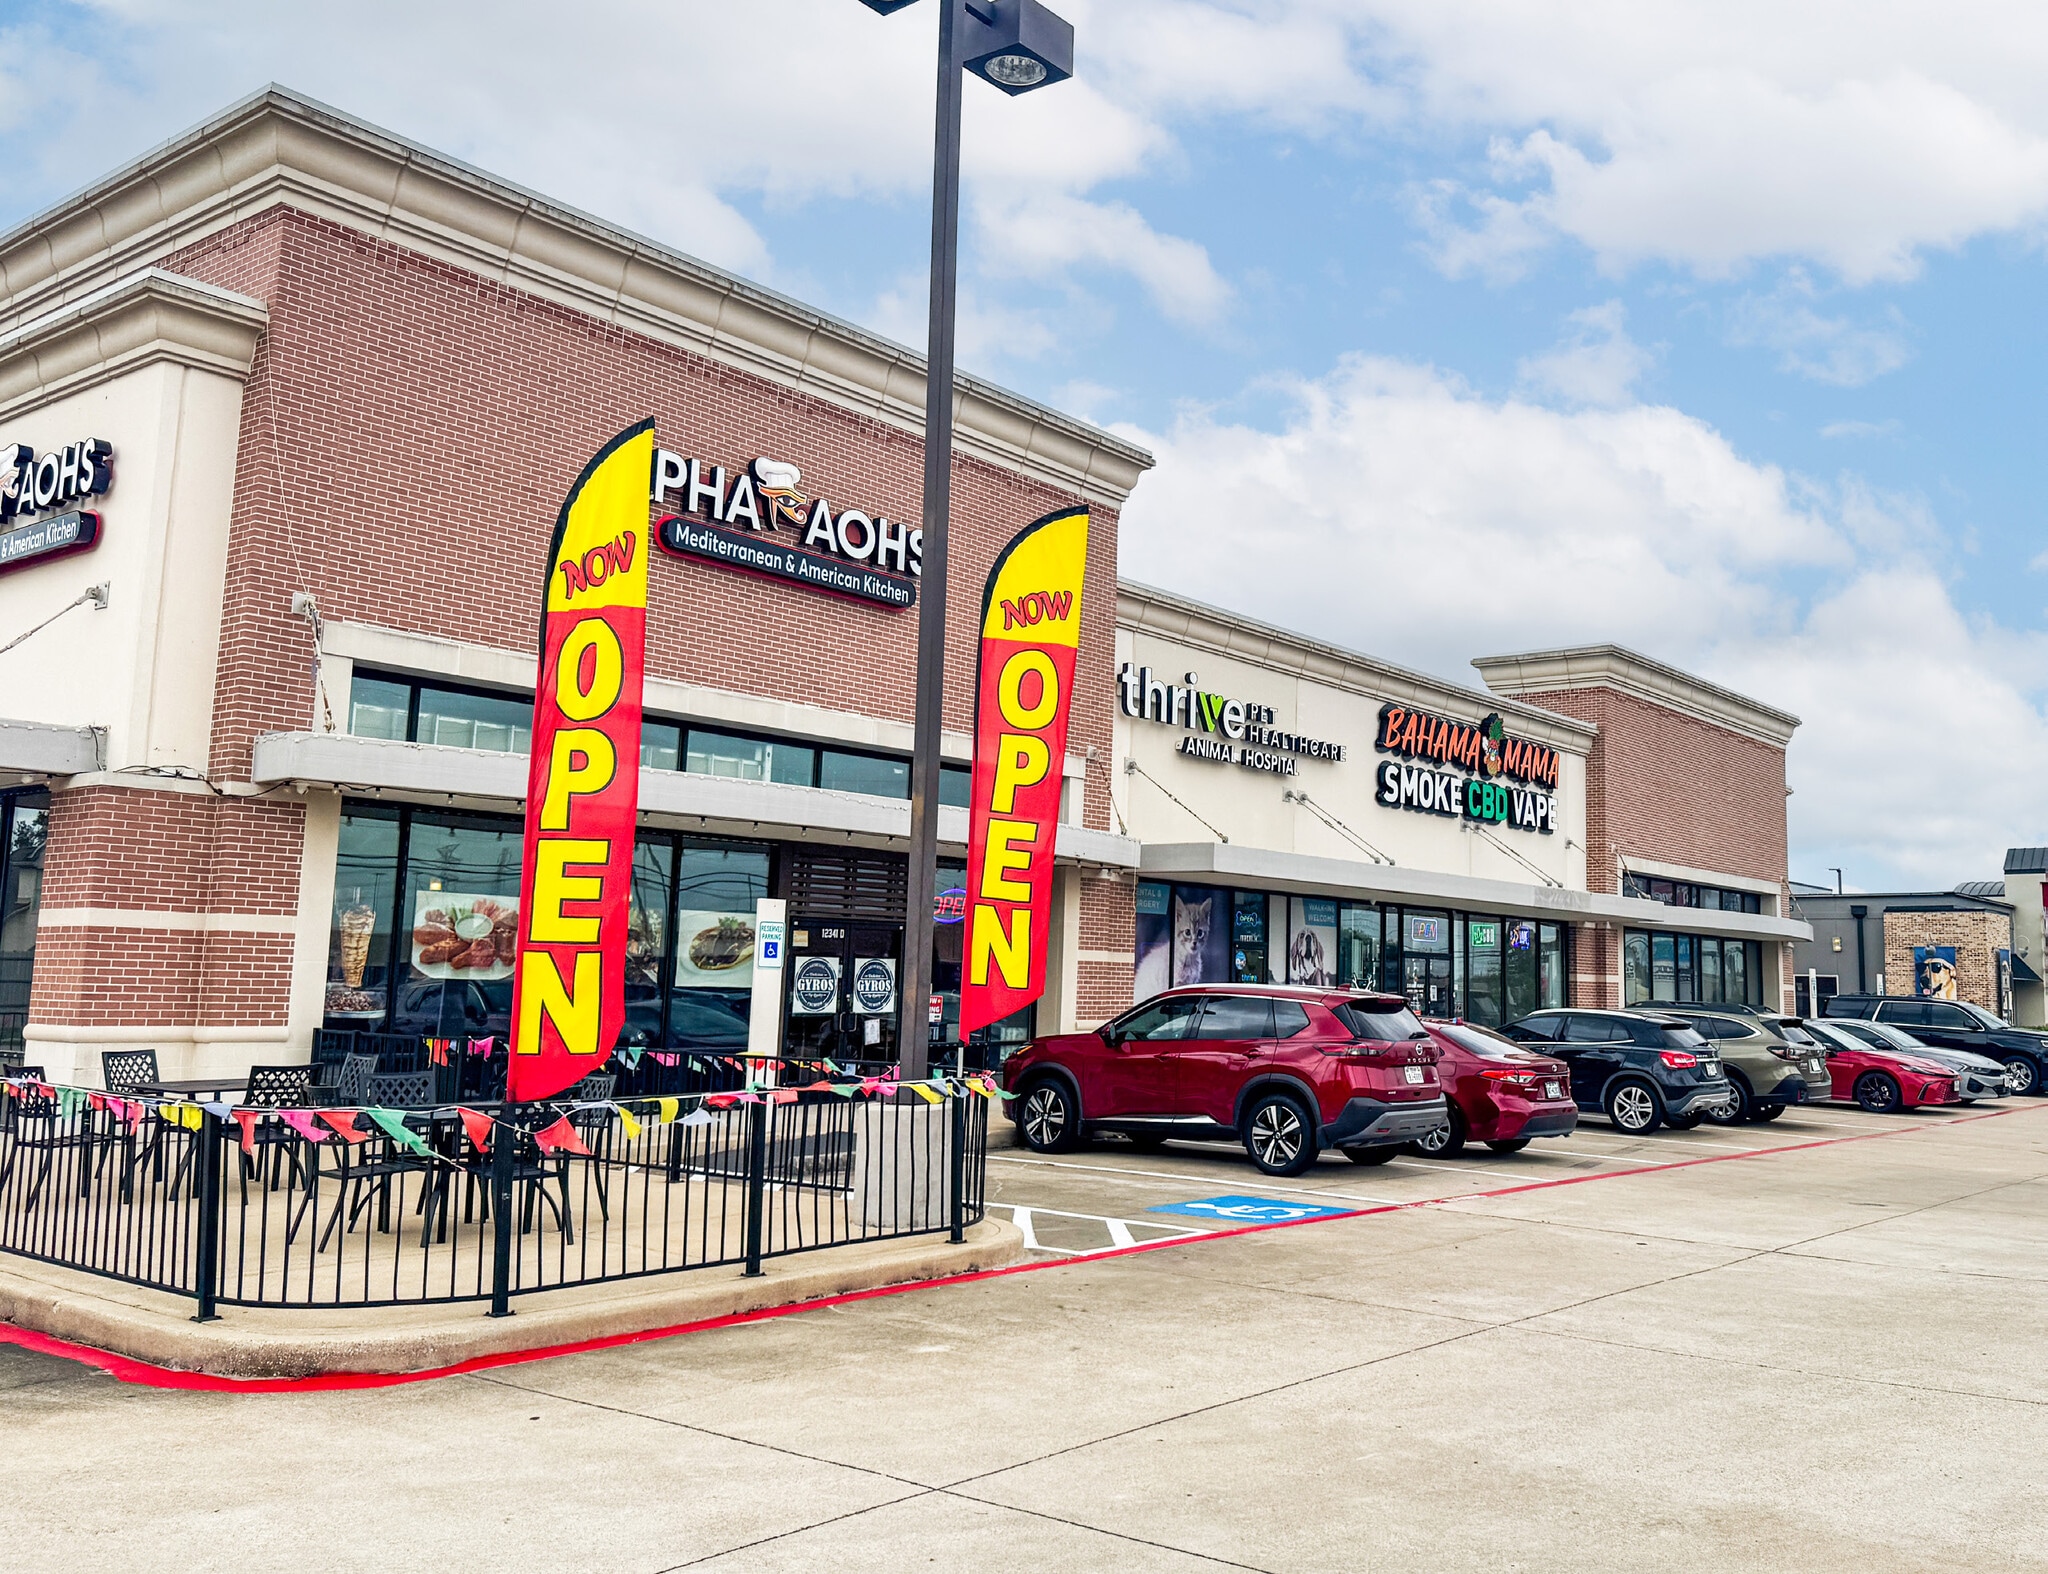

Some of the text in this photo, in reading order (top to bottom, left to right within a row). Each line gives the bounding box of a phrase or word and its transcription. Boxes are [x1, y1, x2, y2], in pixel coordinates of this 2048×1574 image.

[2, 518, 77, 558] & American Kitchen
[560, 530, 636, 600] NOW
[675, 522, 909, 604] Mediterranean & American Kitchen
[1000, 591, 1073, 631] NOW
[1121, 662, 1246, 739] thrive
[1250, 702, 1278, 725] PET
[1185, 736, 1300, 777] ANIMAL HOSPITAL
[1250, 725, 1348, 763] HEALTHCARE
[1383, 708, 1560, 790] BAHAMA MAMA
[1383, 764, 1559, 831] SMOKE CBD VAPE
[516, 617, 625, 1056] OPEN
[970, 650, 1060, 989] OPEN
[761, 924, 784, 932] RESERVED
[761, 933, 782, 941] PARKING
[797, 978, 834, 991] GYROS
[857, 980, 891, 992] GYROS
